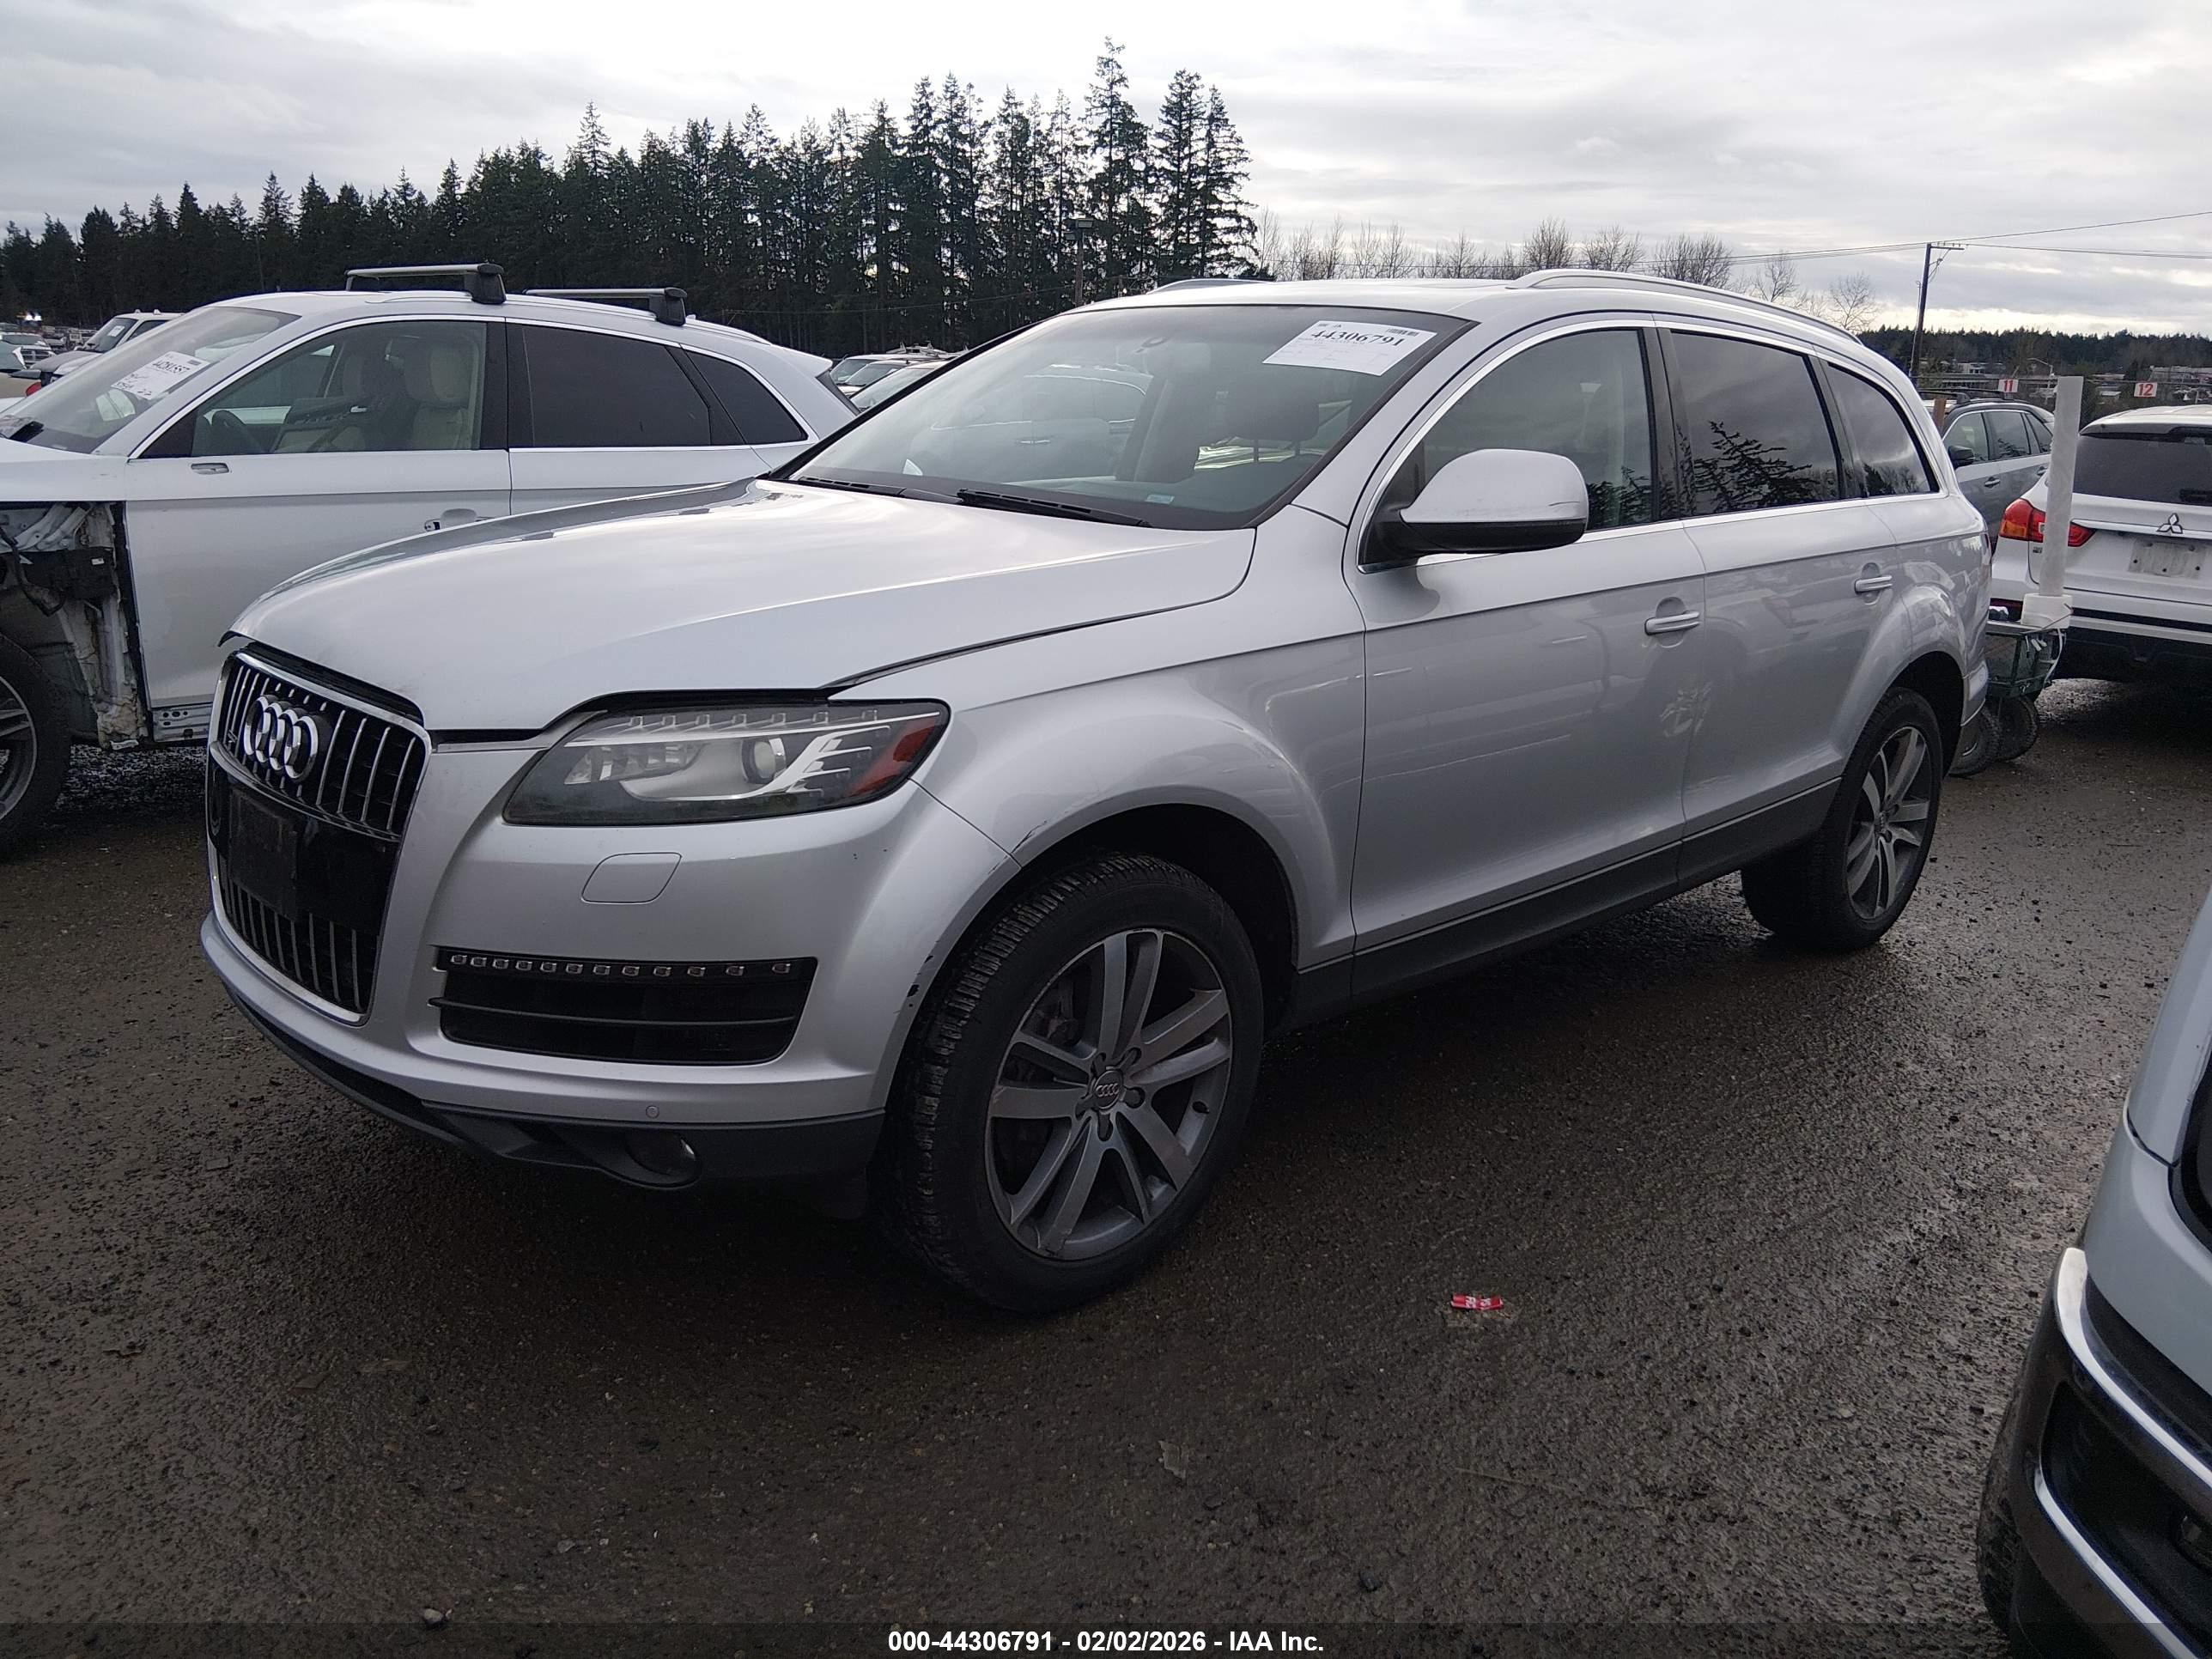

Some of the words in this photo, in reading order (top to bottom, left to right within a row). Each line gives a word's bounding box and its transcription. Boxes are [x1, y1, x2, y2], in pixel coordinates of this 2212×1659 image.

[1312, 330, 1405, 346] 44306791
[2003, 380, 2014, 392] 11
[2139, 383, 2154, 396] 12
